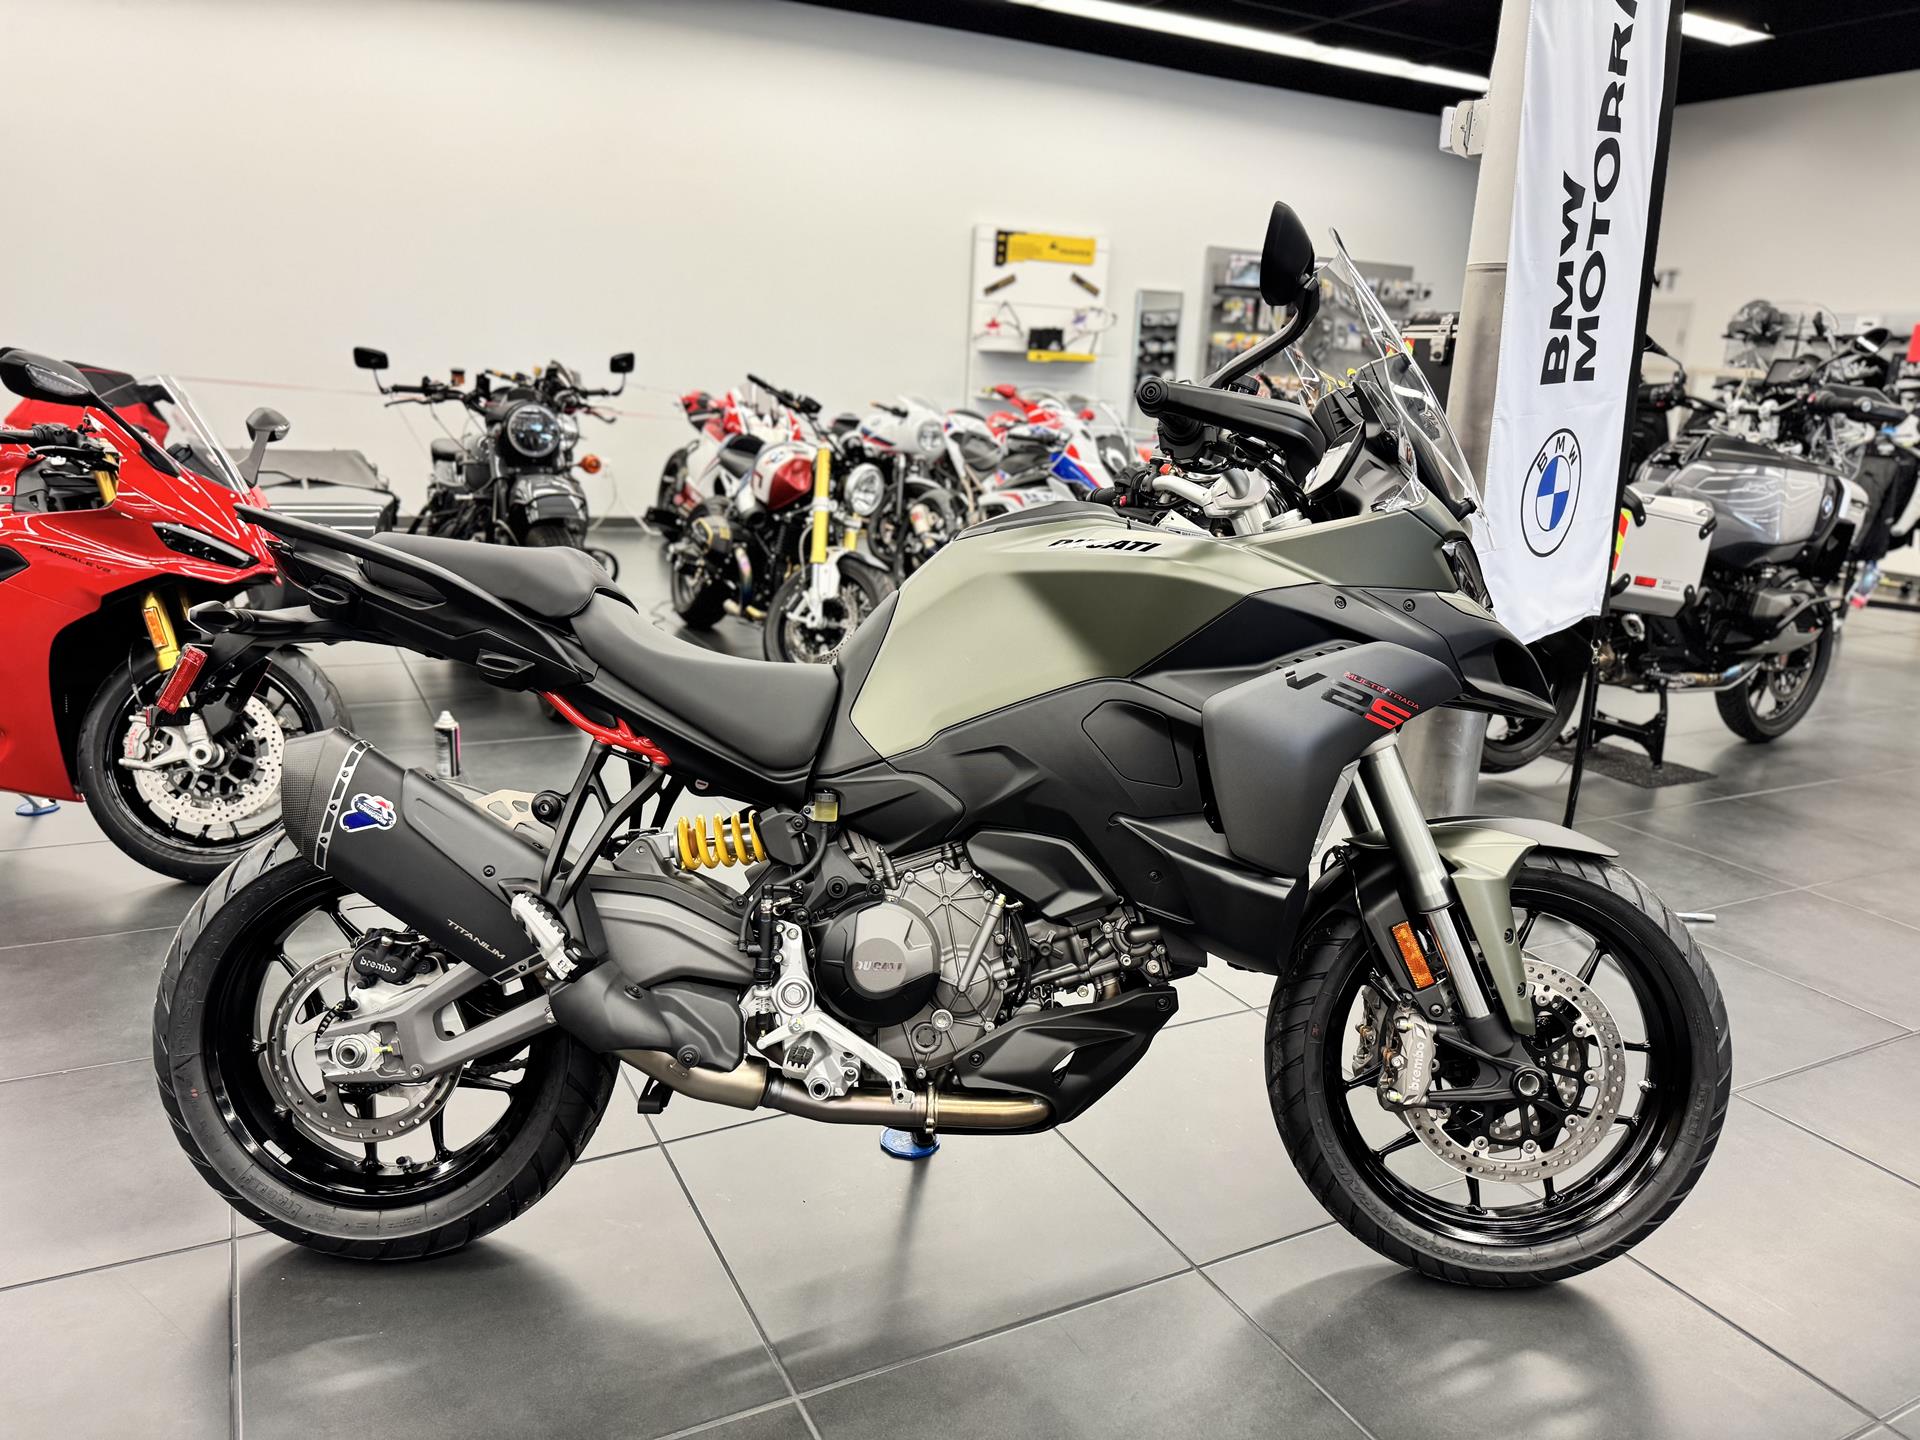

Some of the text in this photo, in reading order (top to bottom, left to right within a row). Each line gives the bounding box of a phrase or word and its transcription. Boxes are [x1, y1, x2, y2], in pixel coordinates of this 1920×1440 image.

[1540, 170, 1586, 385] BMW
[1537, 435, 1578, 474] BMW
[40, 545, 93, 567] PANIGALE
[1343, 671, 1420, 710] MULTISTRADA
[447, 918, 506, 960] TITANIUM
[360, 956, 397, 974] brembo
[855, 960, 903, 970] DUCATI
[1408, 1042, 1425, 1091] brembo
